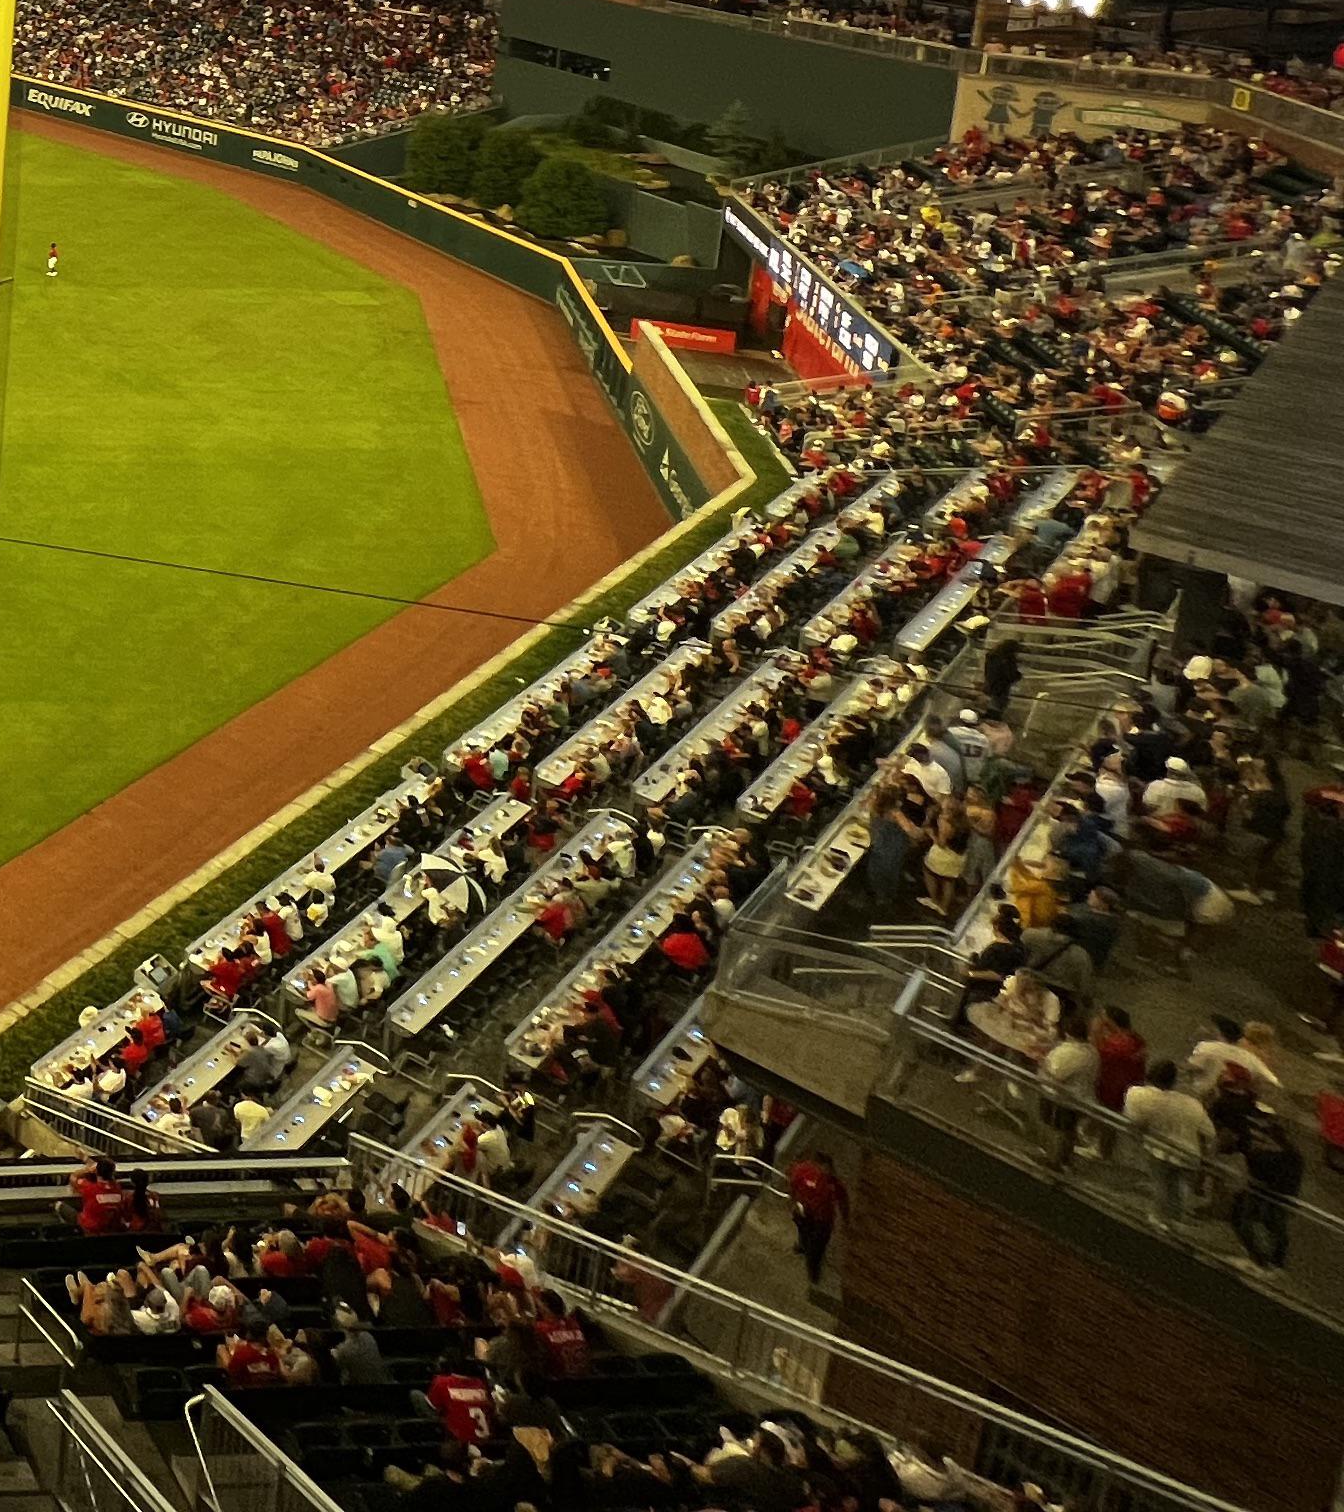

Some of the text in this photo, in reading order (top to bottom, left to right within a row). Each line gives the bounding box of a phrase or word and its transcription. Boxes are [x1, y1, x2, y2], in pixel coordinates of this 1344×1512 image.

[27, 89, 93, 117] EQUIFAX
[152, 118, 218, 146] HYUNDAI
[468, 1407, 490, 1438] 3
